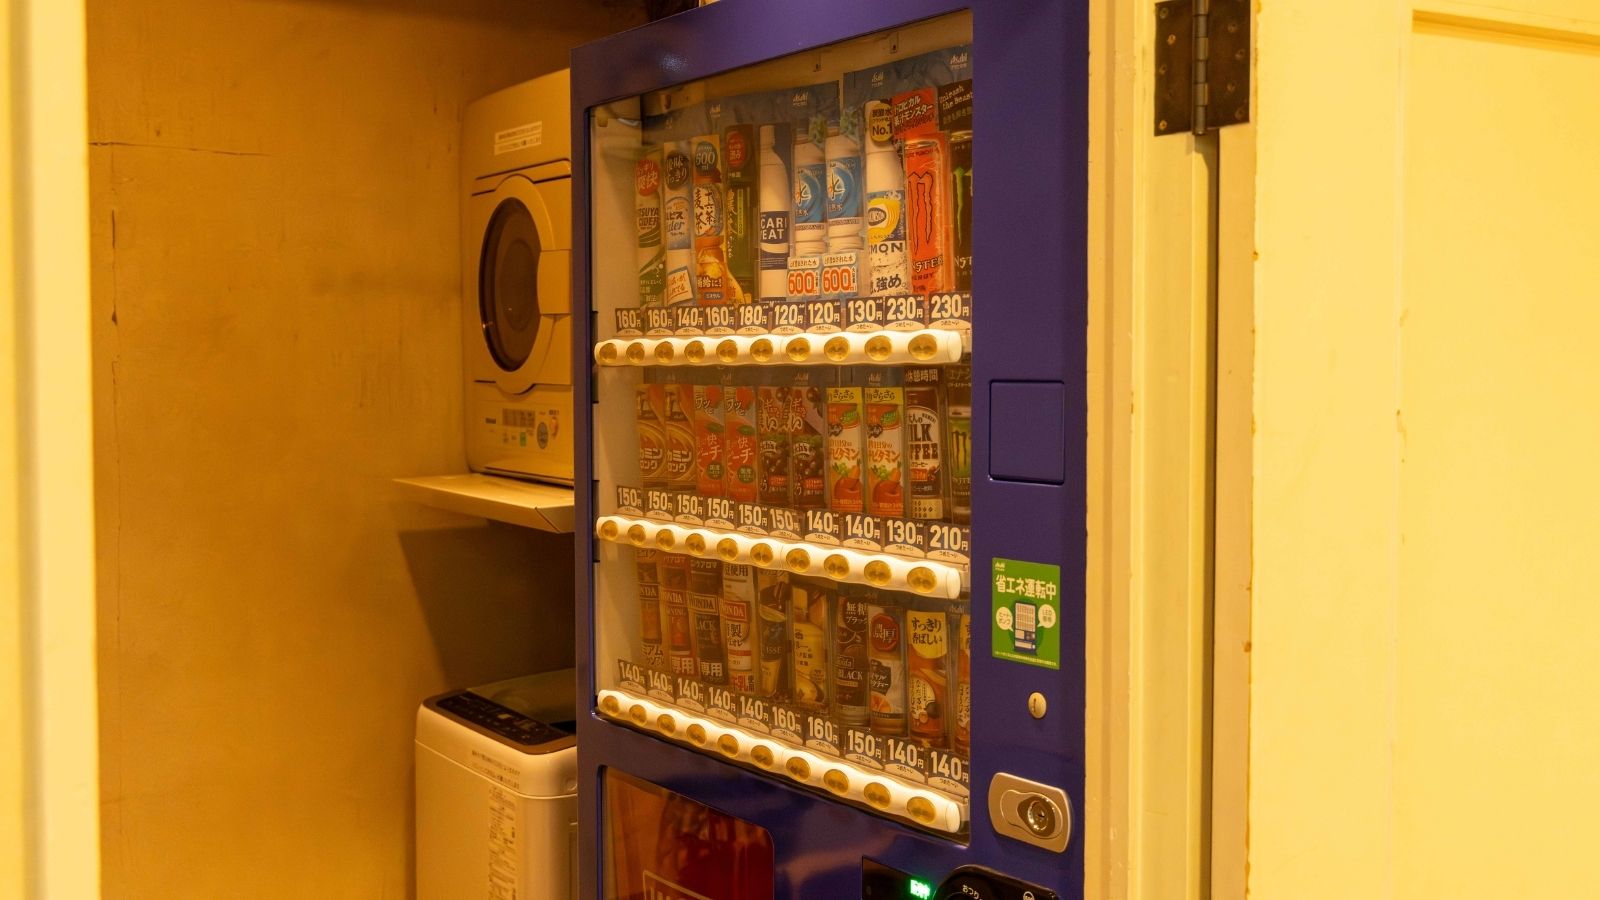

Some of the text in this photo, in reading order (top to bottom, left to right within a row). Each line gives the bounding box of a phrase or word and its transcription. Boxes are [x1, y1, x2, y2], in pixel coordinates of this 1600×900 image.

[760, 229, 785, 241] EAT
[788, 271, 814, 296] 600
[823, 268, 851, 293] 600
[648, 308, 672, 328] 160円
[677, 307, 703, 327] 140円
[705, 306, 734, 326] 160円
[739, 305, 767, 326] 180円
[774, 303, 804, 326] 120円
[808, 302, 840, 324] 120円
[848, 299, 882, 322] 130円
[887, 296, 923, 320] 230円
[931, 294, 970, 319] 230円
[616, 309, 641, 329] 160円
[617, 487, 642, 507] 150円
[648, 491, 673, 511] 150円
[677, 494, 703, 516] 150円
[707, 498, 734, 519] 150円
[738, 504, 767, 527] 150円
[770, 508, 799, 532] 150円
[806, 510, 839, 534] 140円
[845, 514, 880, 540] 140円
[887, 519, 923, 545] 130円
[929, 525, 969, 552] 210円
[996, 574, 1057, 600] 省エネ運転中
[911, 617, 942, 633] すっきり
[619, 661, 645, 685] 140円
[648, 670, 673, 693] 140円
[677, 677, 703, 702] 140円
[708, 687, 736, 713] 140円
[740, 696, 769, 722] 140円
[772, 706, 801, 734] 160円
[807, 716, 838, 745] 160円
[847, 729, 882, 759] 150円
[887, 739, 924, 770] 140円
[930, 751, 969, 784] 140円
